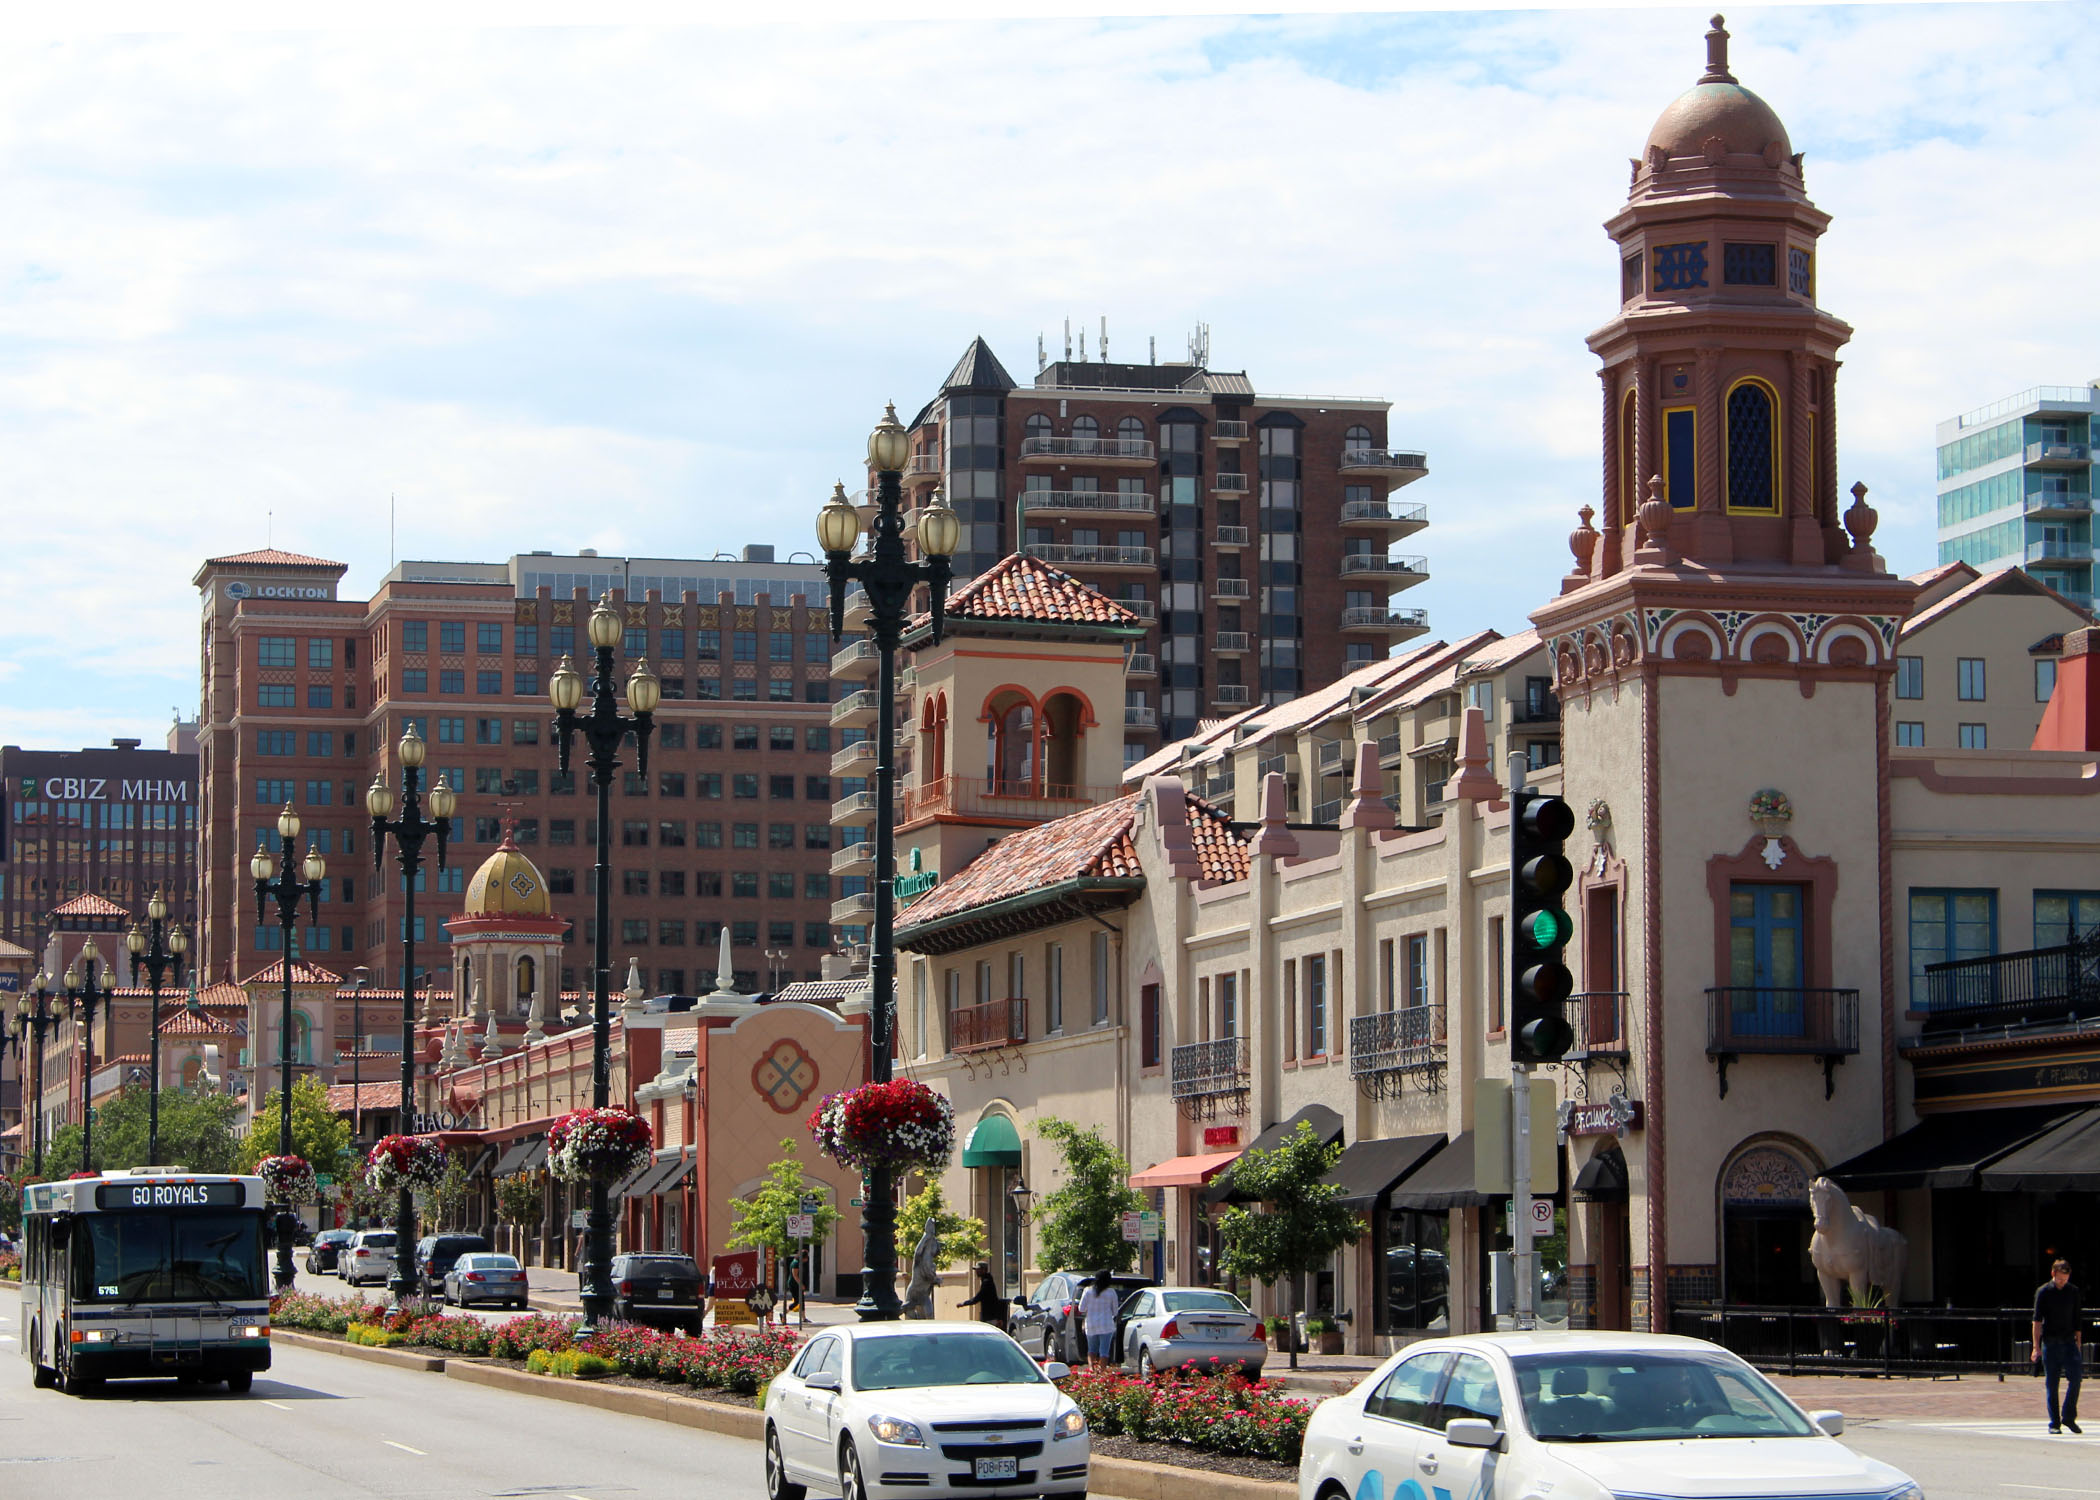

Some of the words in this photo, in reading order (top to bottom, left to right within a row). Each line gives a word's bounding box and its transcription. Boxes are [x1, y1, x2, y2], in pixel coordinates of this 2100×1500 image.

[257, 586, 328, 599] LOCKTON
[45, 777, 107, 800] CBIZ
[121, 778, 187, 802] MHM
[893, 870, 937, 899] Commerce
[132, 1186, 150, 1205] GO
[154, 1185, 208, 1204] ROYALS
[716, 1280, 756, 1289] PLAZA
[231, 1317, 256, 1326] S165
